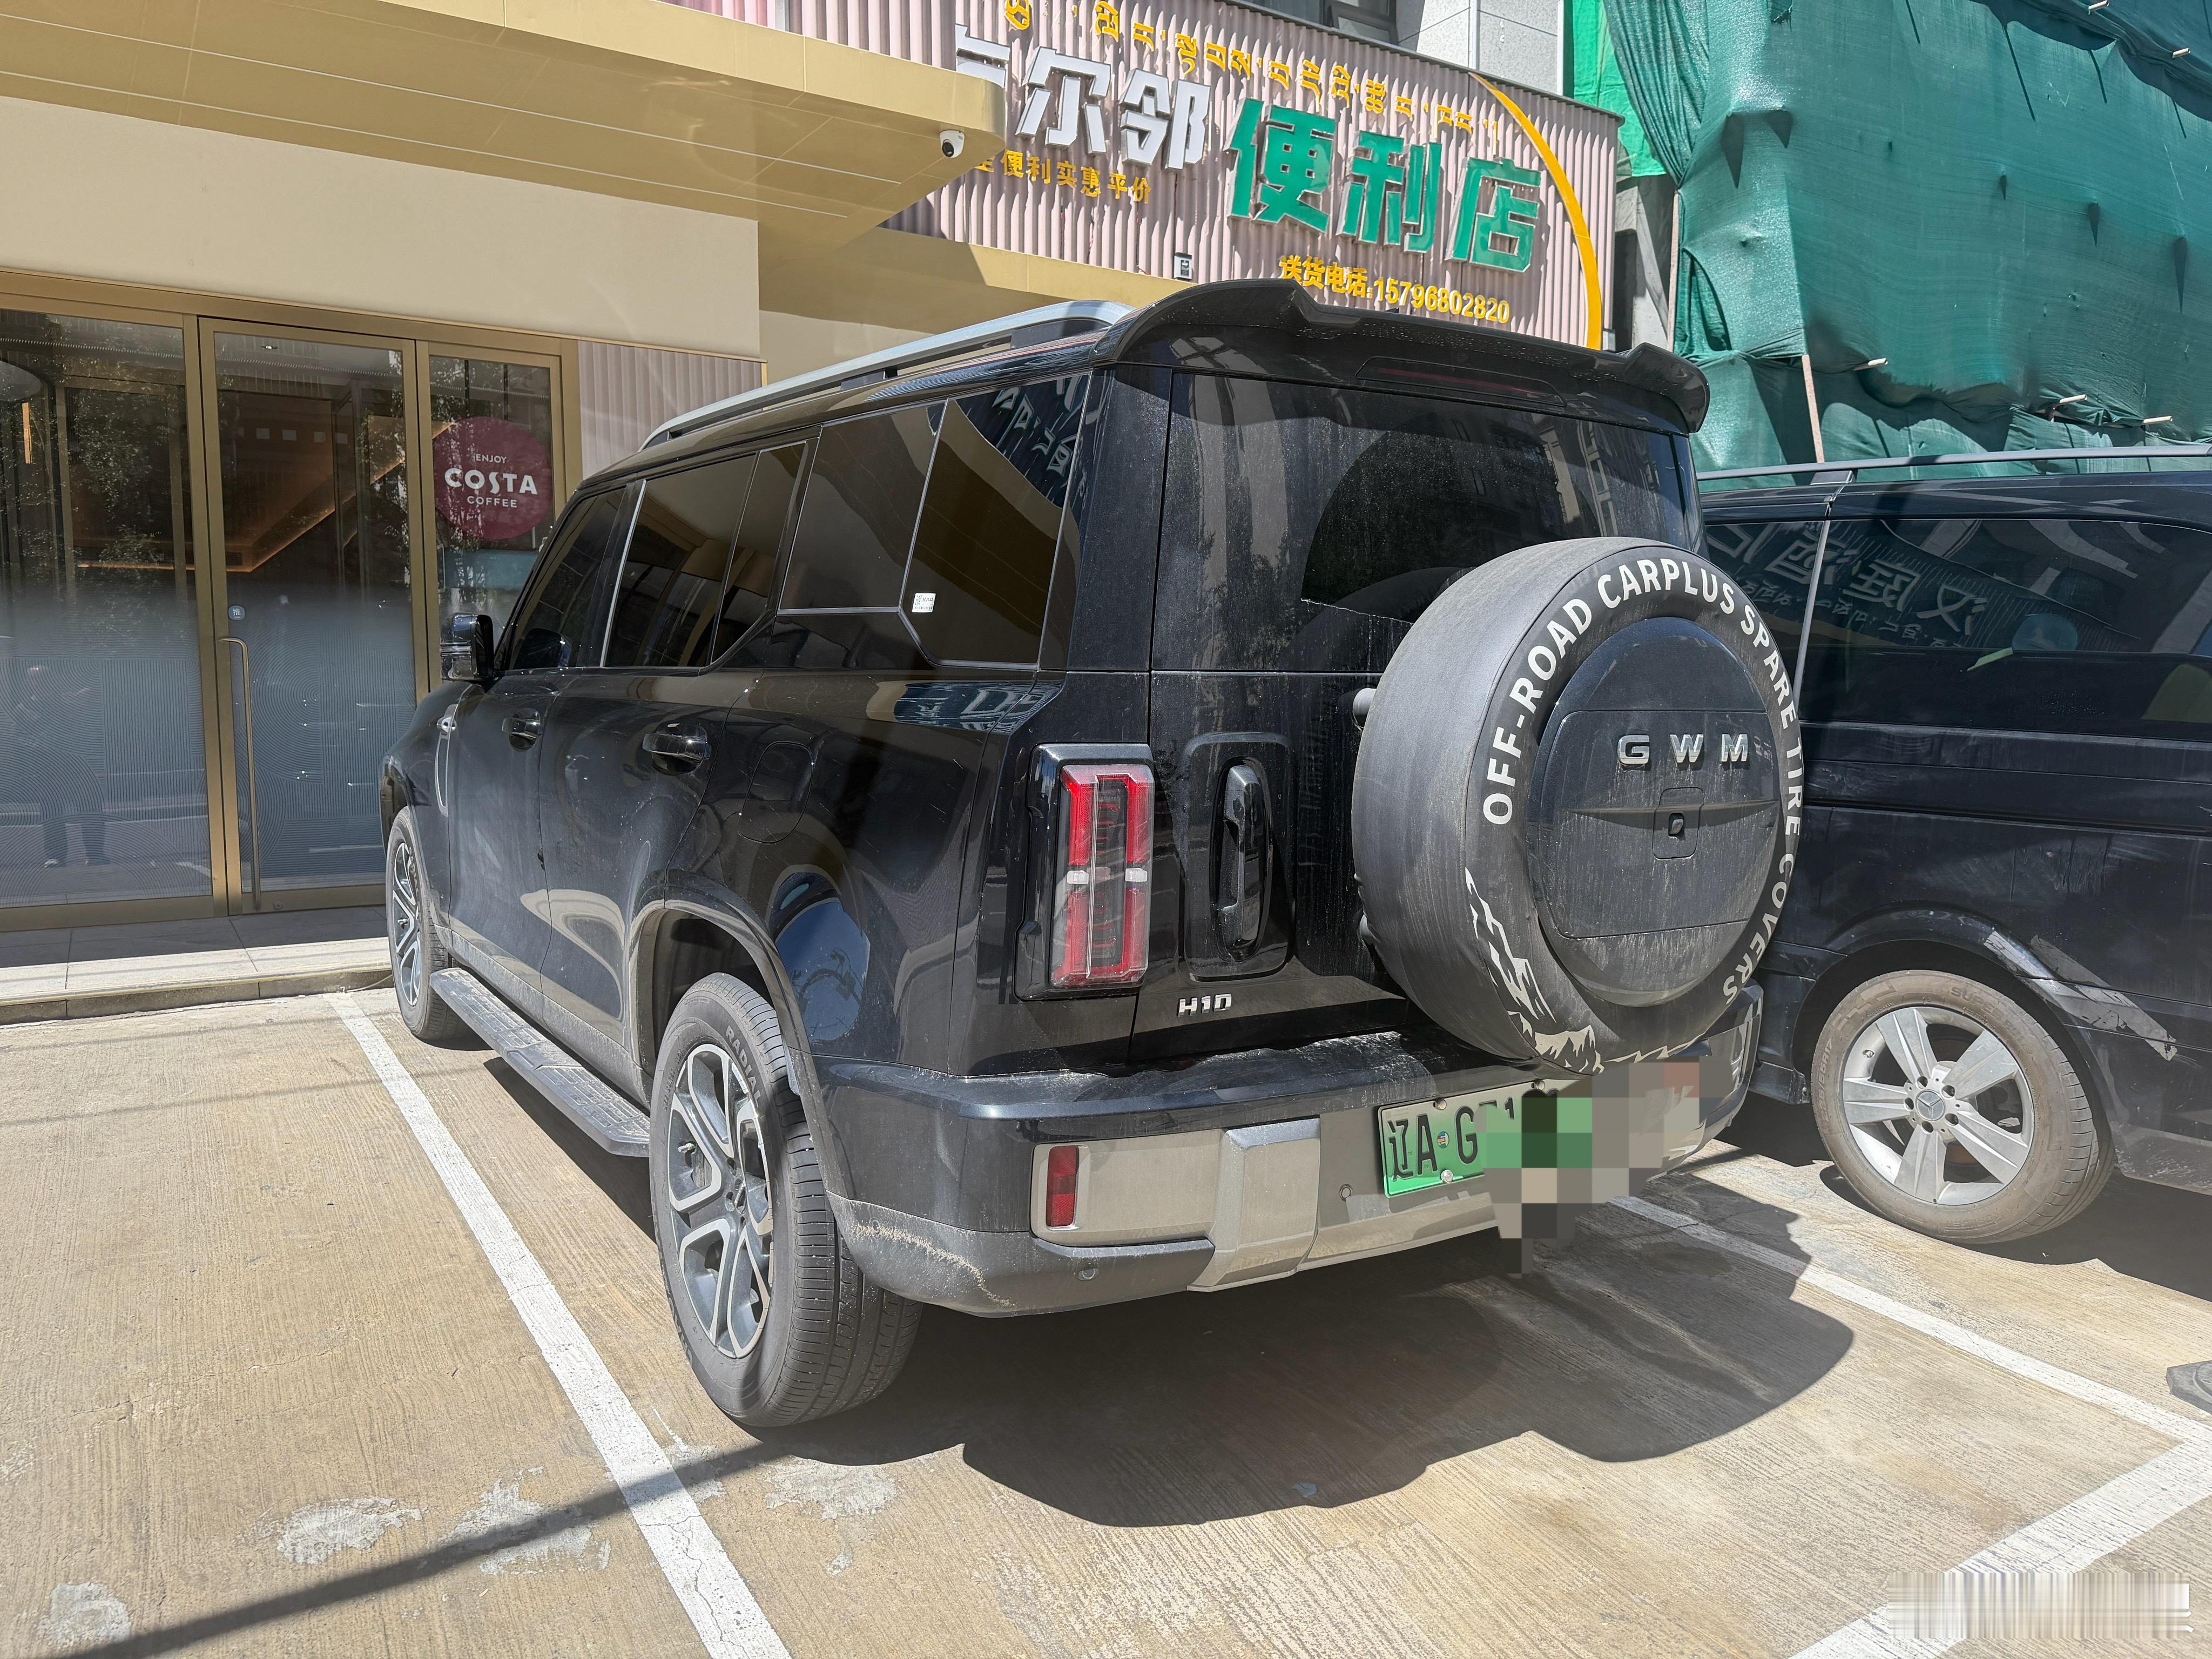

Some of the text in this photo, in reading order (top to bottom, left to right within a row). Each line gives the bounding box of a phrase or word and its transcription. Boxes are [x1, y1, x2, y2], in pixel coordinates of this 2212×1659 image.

[1224, 98, 1542, 272] 便利店
[476, 454, 507, 463] ENJOY
[444, 468, 538, 495] COSTA
[467, 496, 517, 508] COFFEE
[1617, 733, 1748, 764] GWM
[1483, 558, 1803, 1004] OFF-ROAD CARPLUS SPARE TIRE COVERS
[725, 1024, 760, 1108] RADIAL
